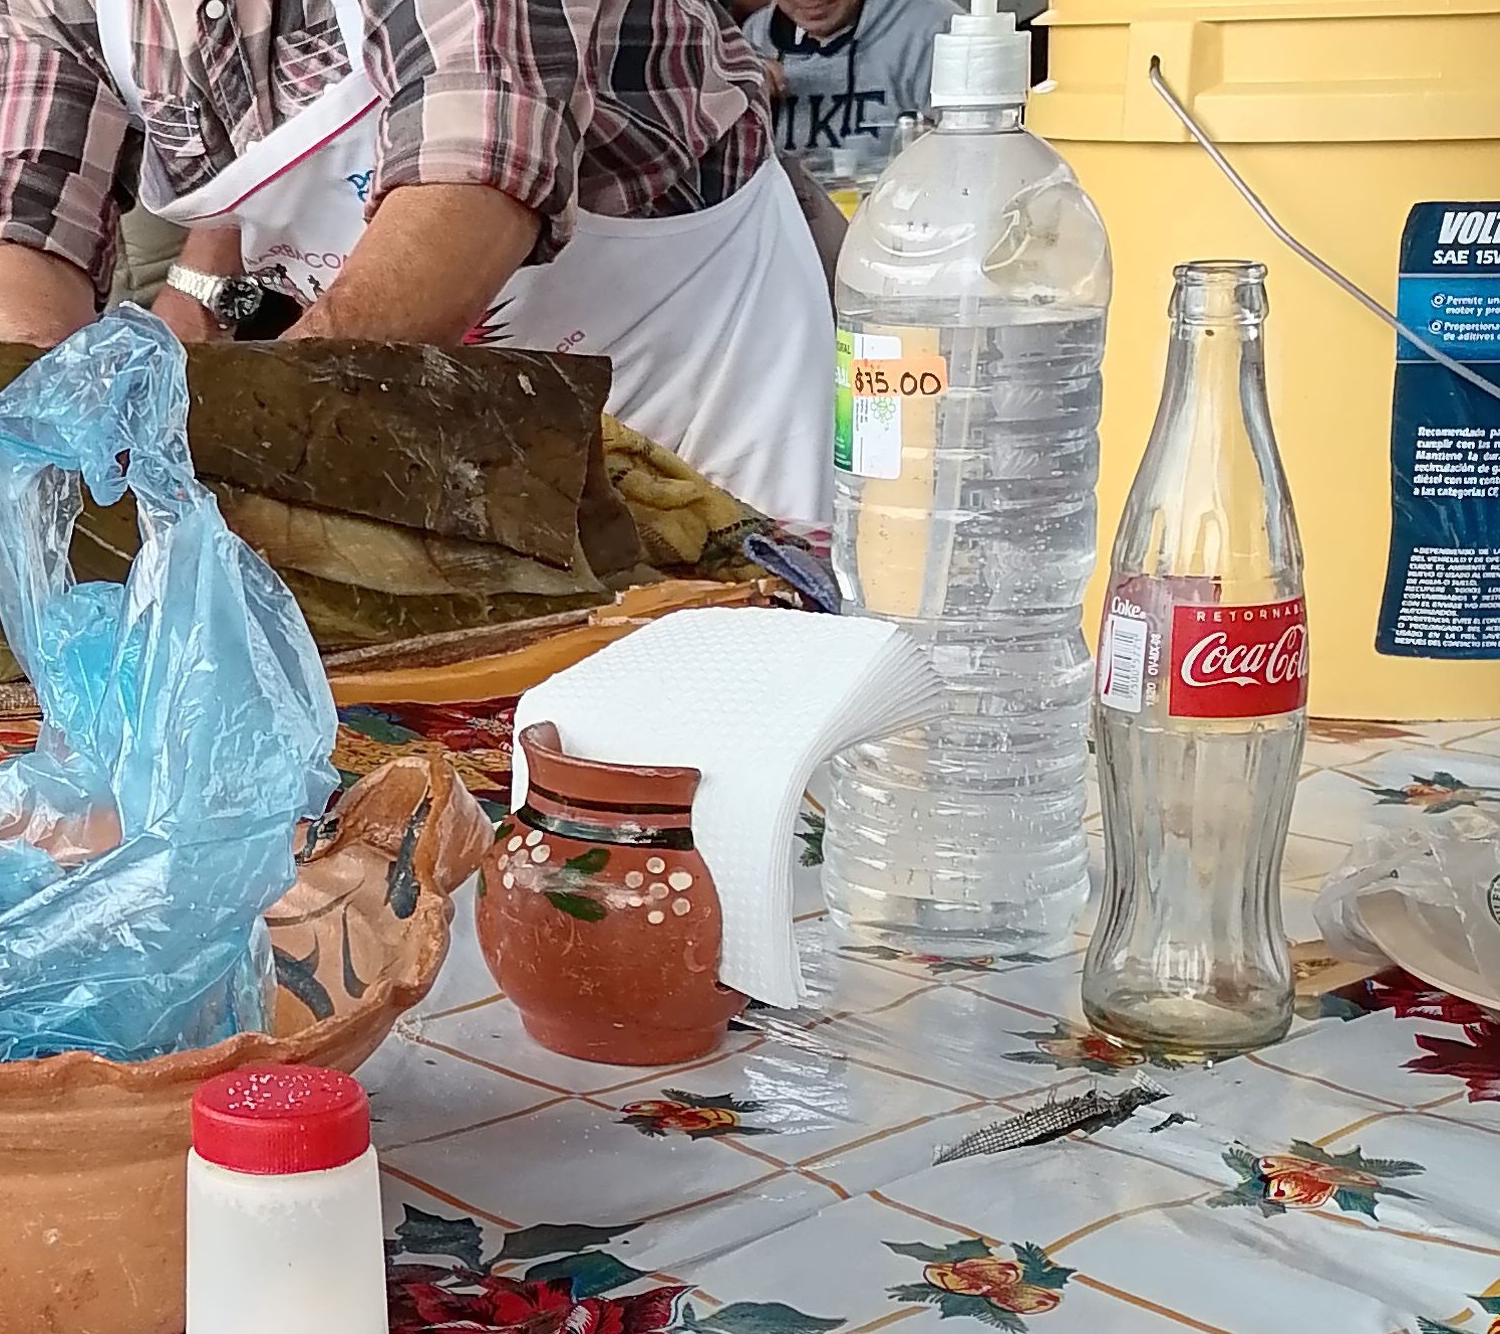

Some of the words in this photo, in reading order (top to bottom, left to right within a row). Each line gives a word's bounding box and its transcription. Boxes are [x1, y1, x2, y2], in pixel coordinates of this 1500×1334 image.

[1432, 249, 1470, 265] SAE
[1446, 296, 1484, 306] Permite
[1445, 306, 1475, 315] motor
[1476, 307, 1484, 317] y
[854, 366, 942, 396] $75.00
[1417, 426, 1486, 437] Recomendado
